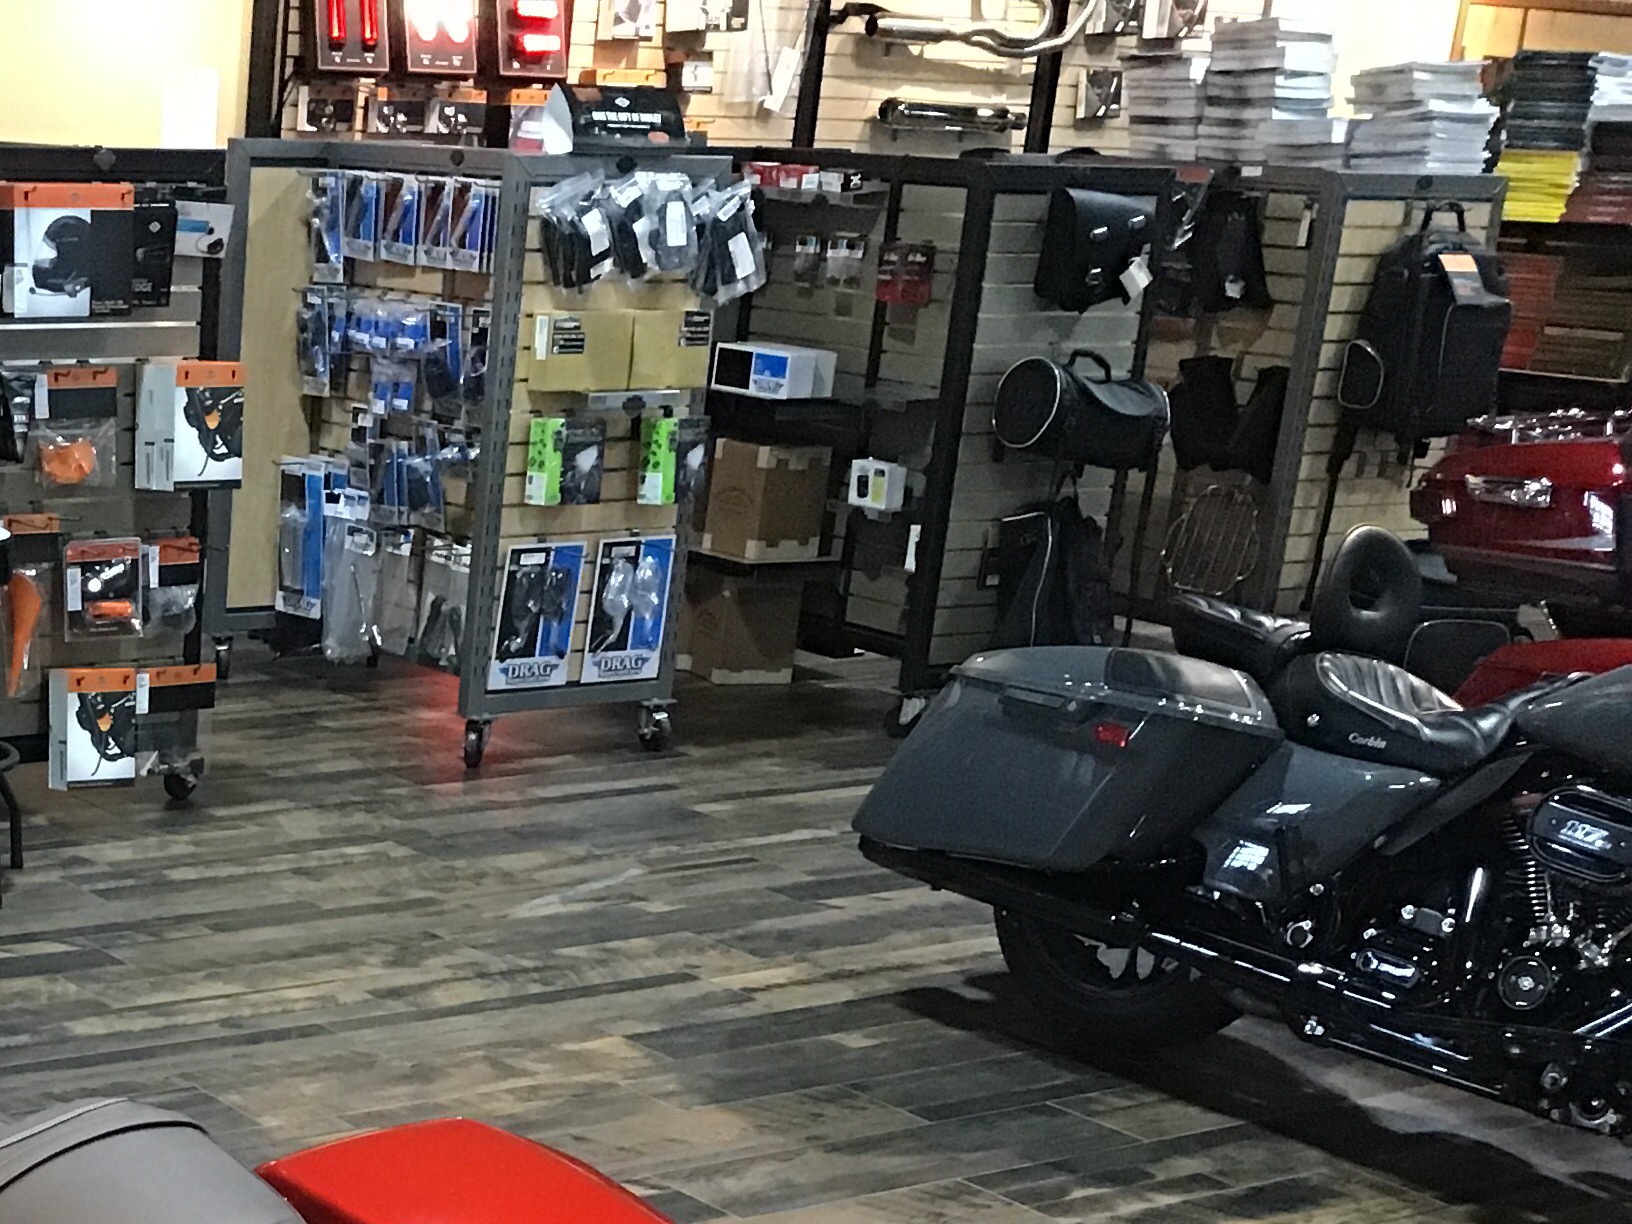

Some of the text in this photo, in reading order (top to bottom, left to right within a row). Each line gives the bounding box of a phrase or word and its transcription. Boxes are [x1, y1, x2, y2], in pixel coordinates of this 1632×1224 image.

[508, 661, 552, 678] DRAG
[600, 653, 643, 672] DRAG
[1348, 732, 1387, 749] Corbin
